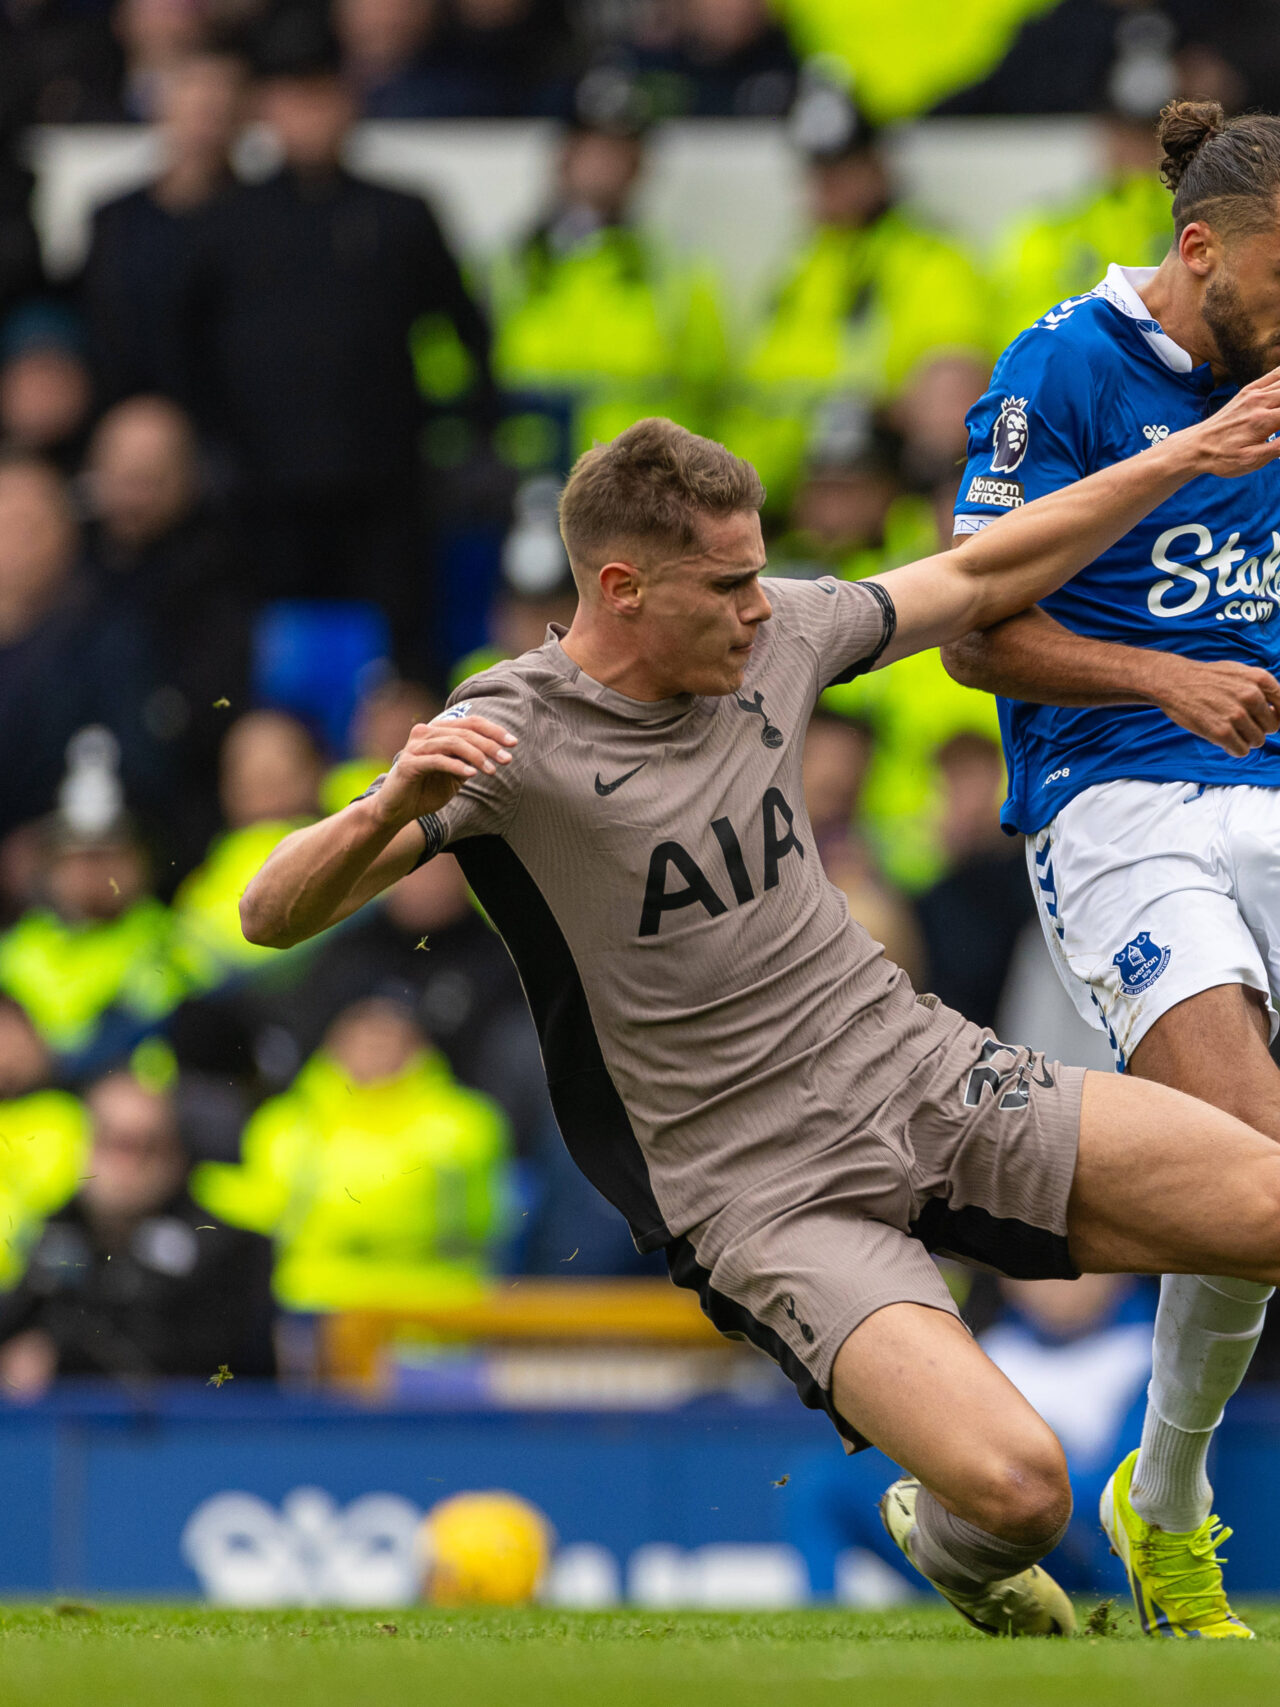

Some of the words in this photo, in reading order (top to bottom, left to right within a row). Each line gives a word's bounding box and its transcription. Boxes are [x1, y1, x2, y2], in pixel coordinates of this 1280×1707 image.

[1215, 600, 1273, 622] .com
[638, 786, 805, 937] AIA
[1128, 956, 1159, 983] Everton
